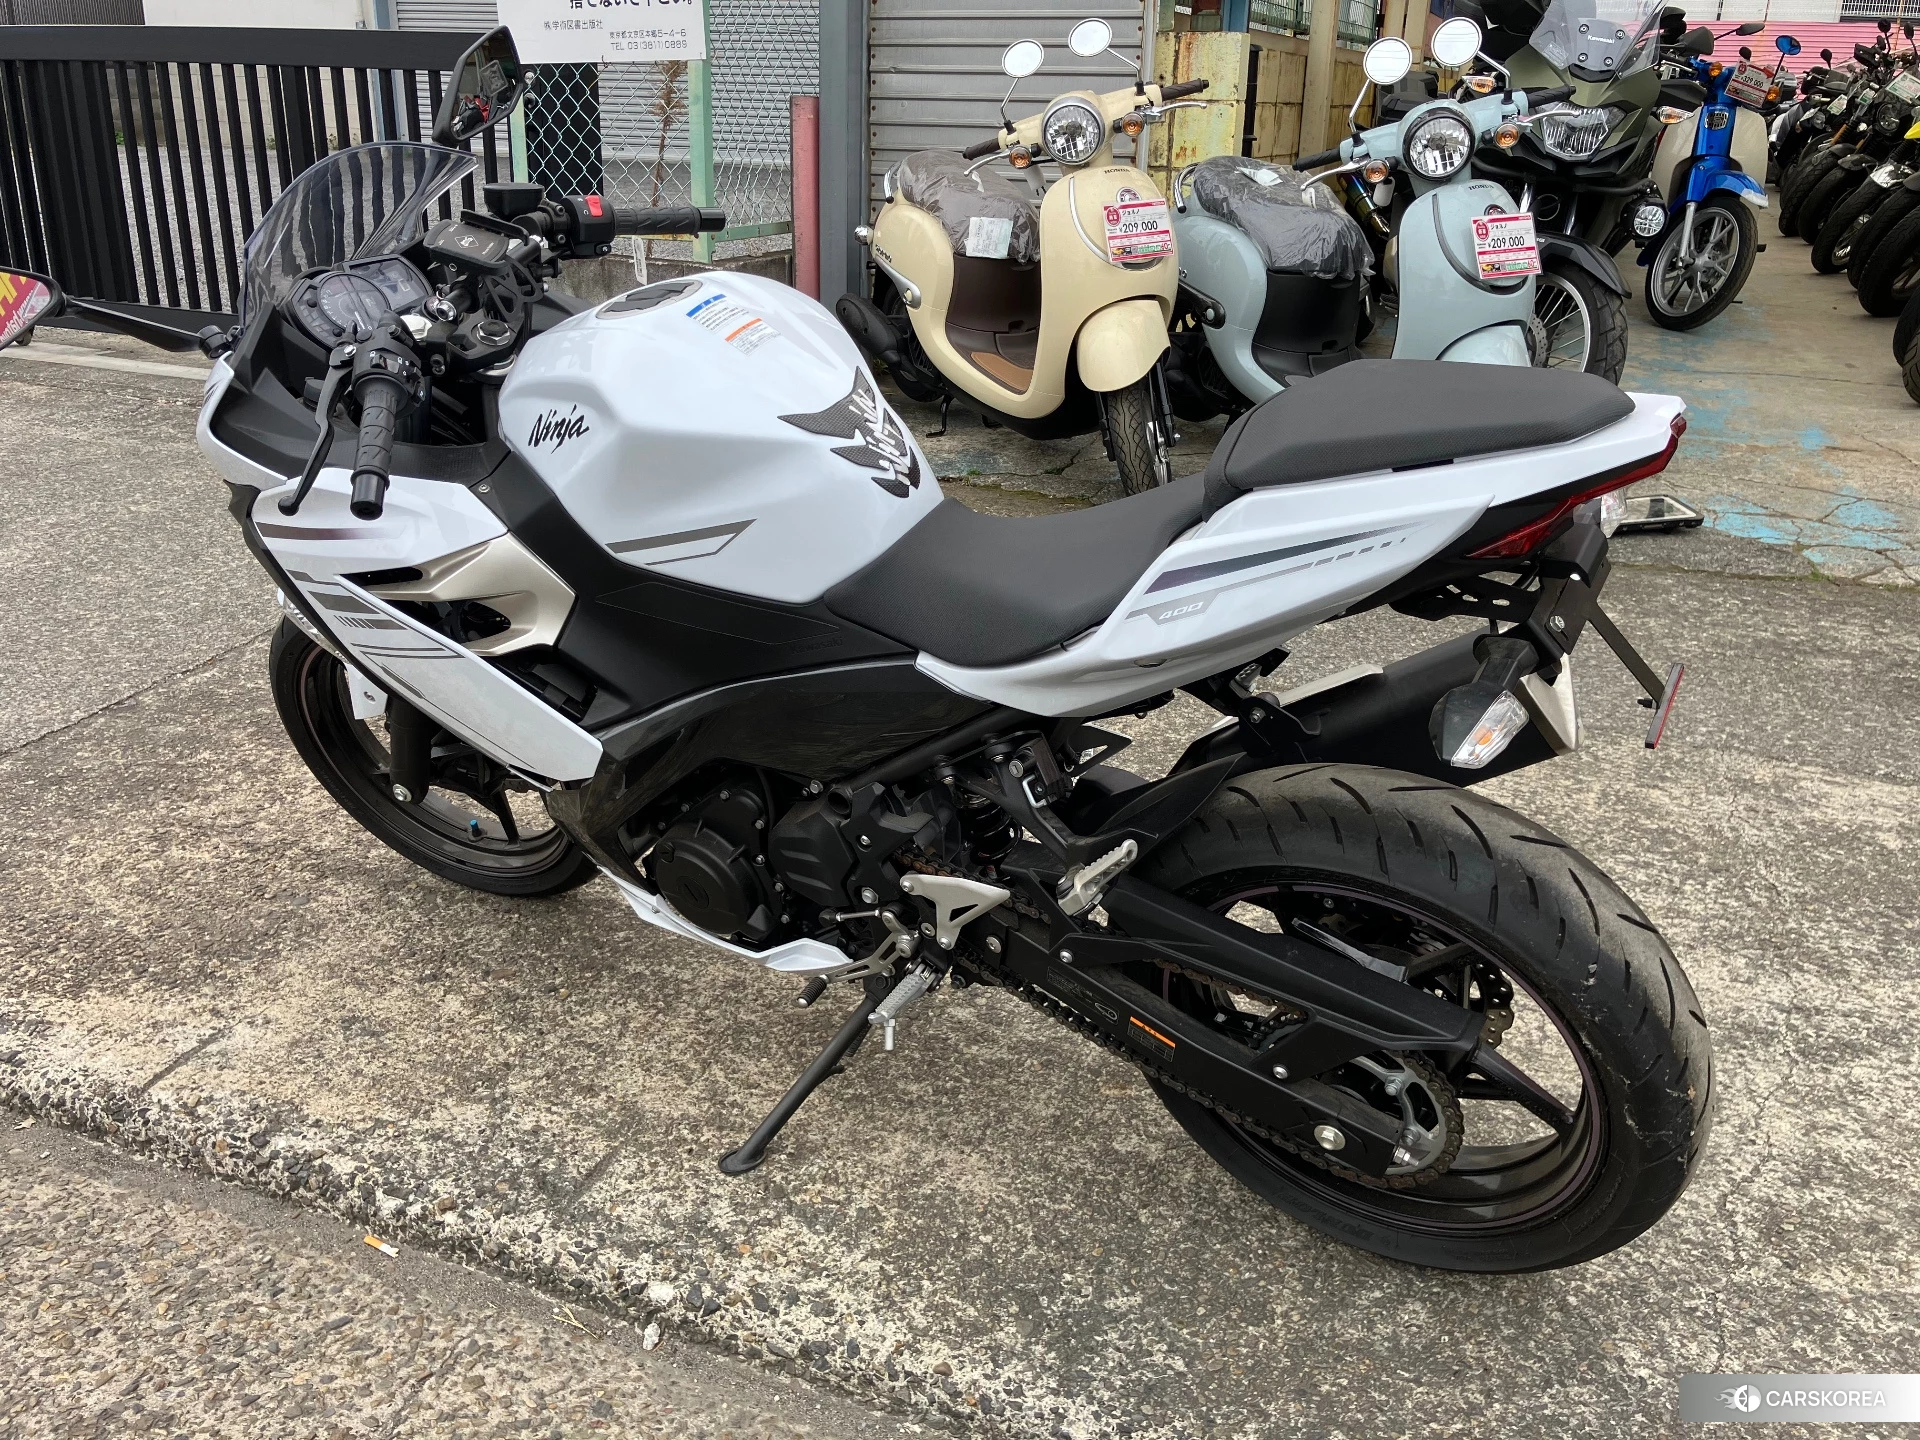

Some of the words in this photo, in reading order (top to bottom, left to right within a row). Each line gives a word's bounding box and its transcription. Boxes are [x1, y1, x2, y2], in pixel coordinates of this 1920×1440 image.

[1587, 34, 1615, 44] Kawasaki
[610, 42, 625, 51] TEL
[1119, 220, 1158, 234] ¥209,000
[1488, 235, 1525, 249] ¥209,000
[528, 404, 590, 454] Ninja
[1158, 601, 1203, 619] 400
